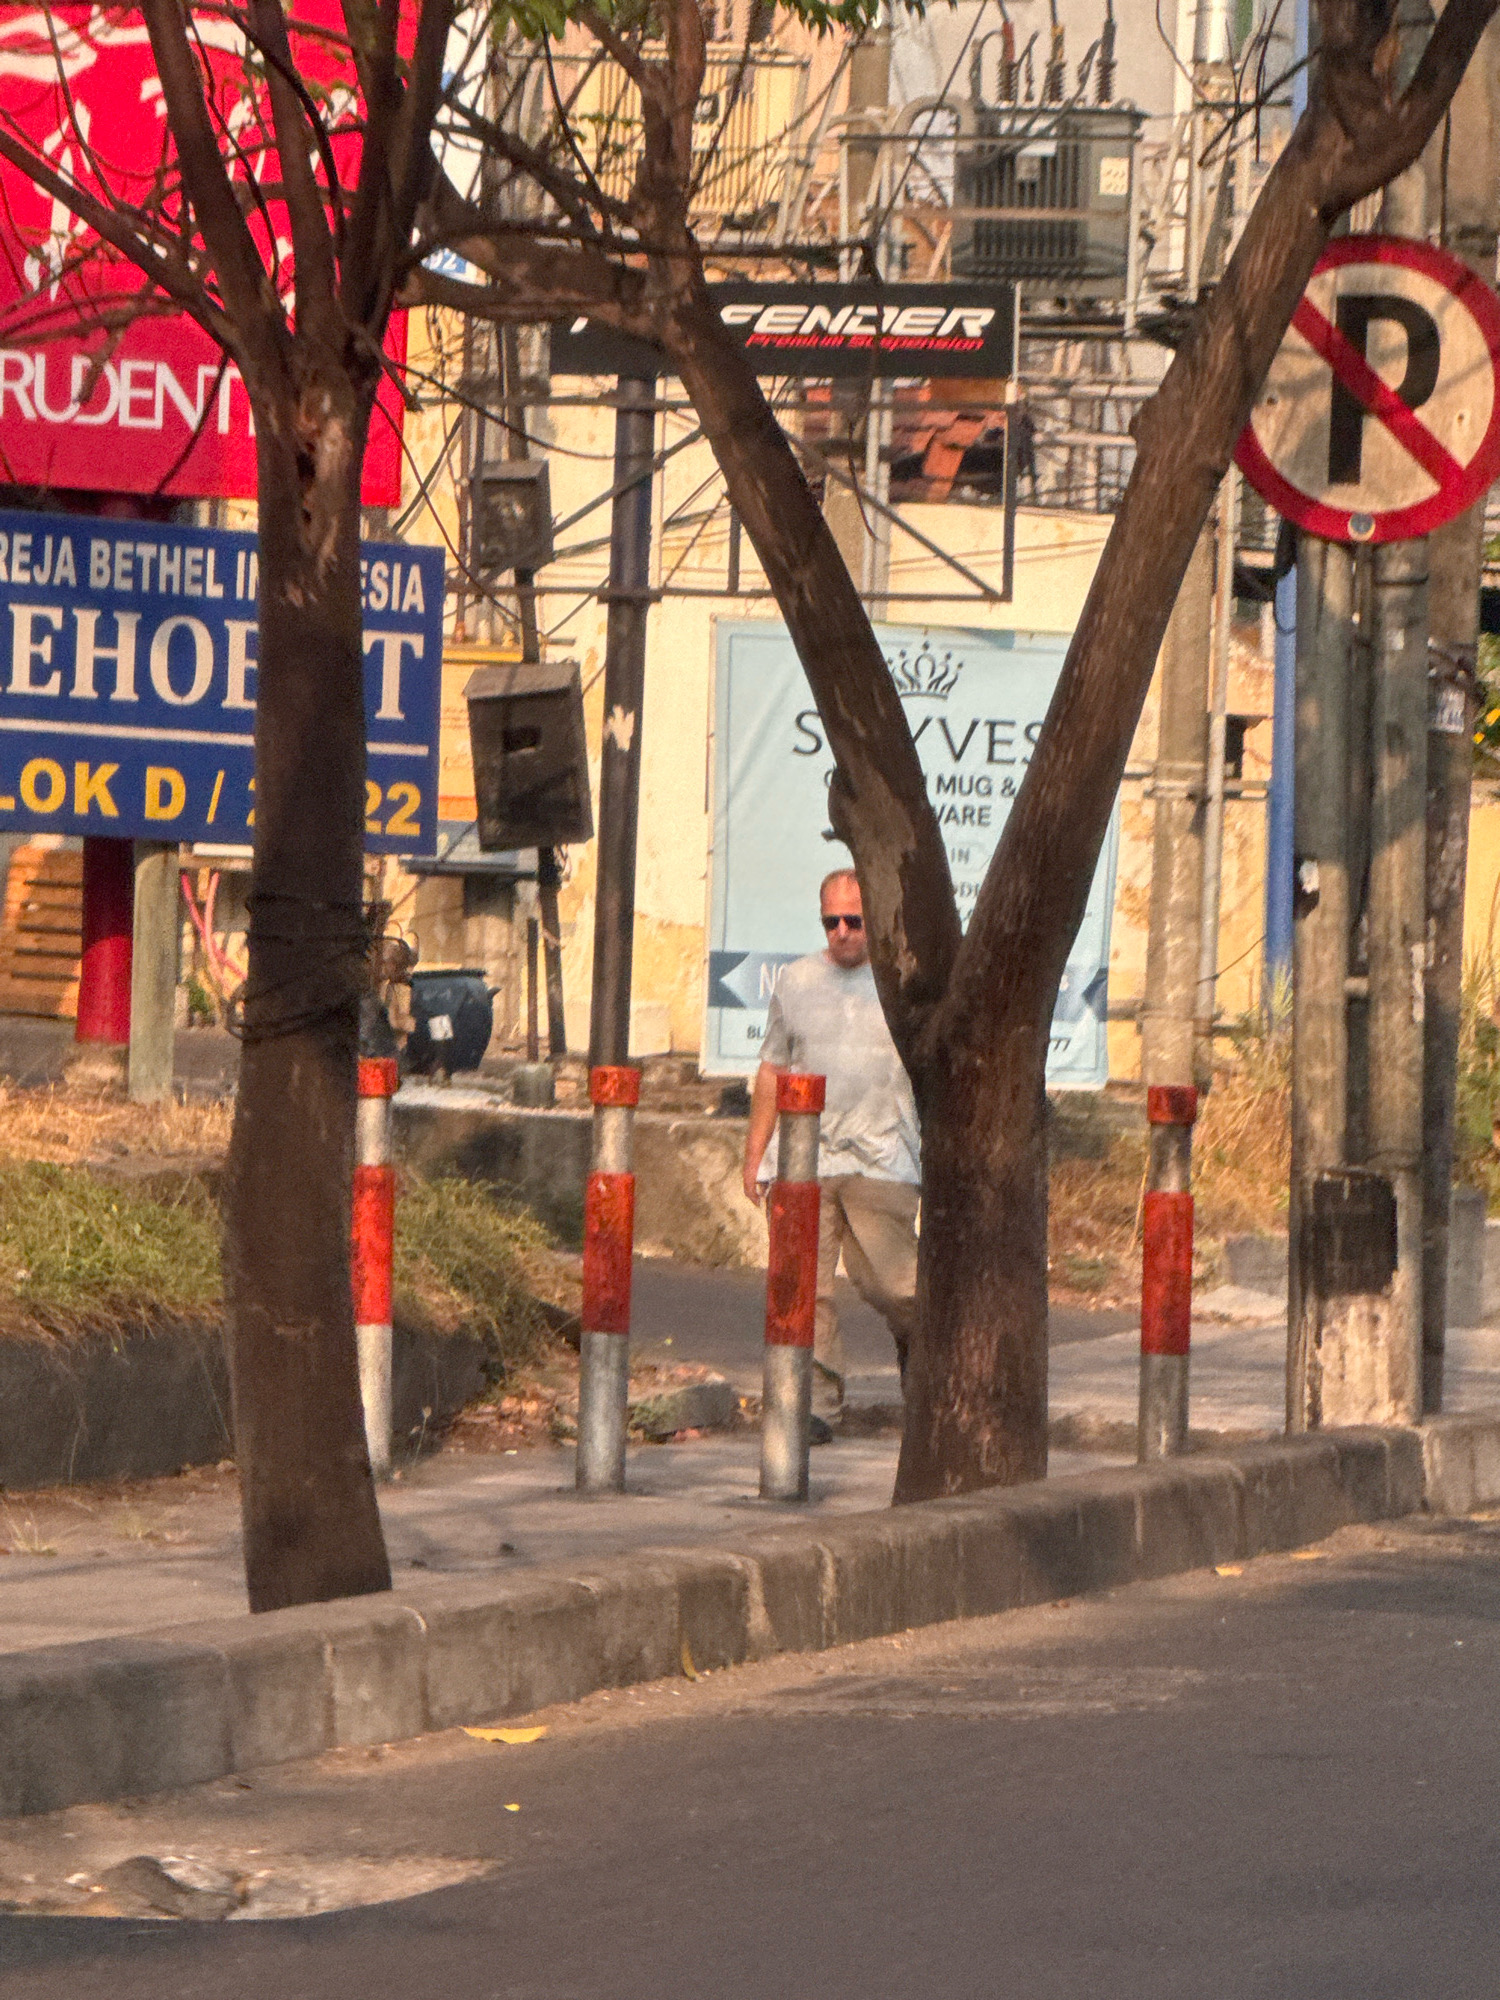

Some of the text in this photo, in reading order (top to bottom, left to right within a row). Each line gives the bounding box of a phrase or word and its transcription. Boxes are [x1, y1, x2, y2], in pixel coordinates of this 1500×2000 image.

[1328, 294, 1440, 485] P
[89, 538, 224, 599] BETHEL
[145, 766, 186, 821] D
[206, 770, 225, 824] /
[936, 773, 993, 796] MUG
